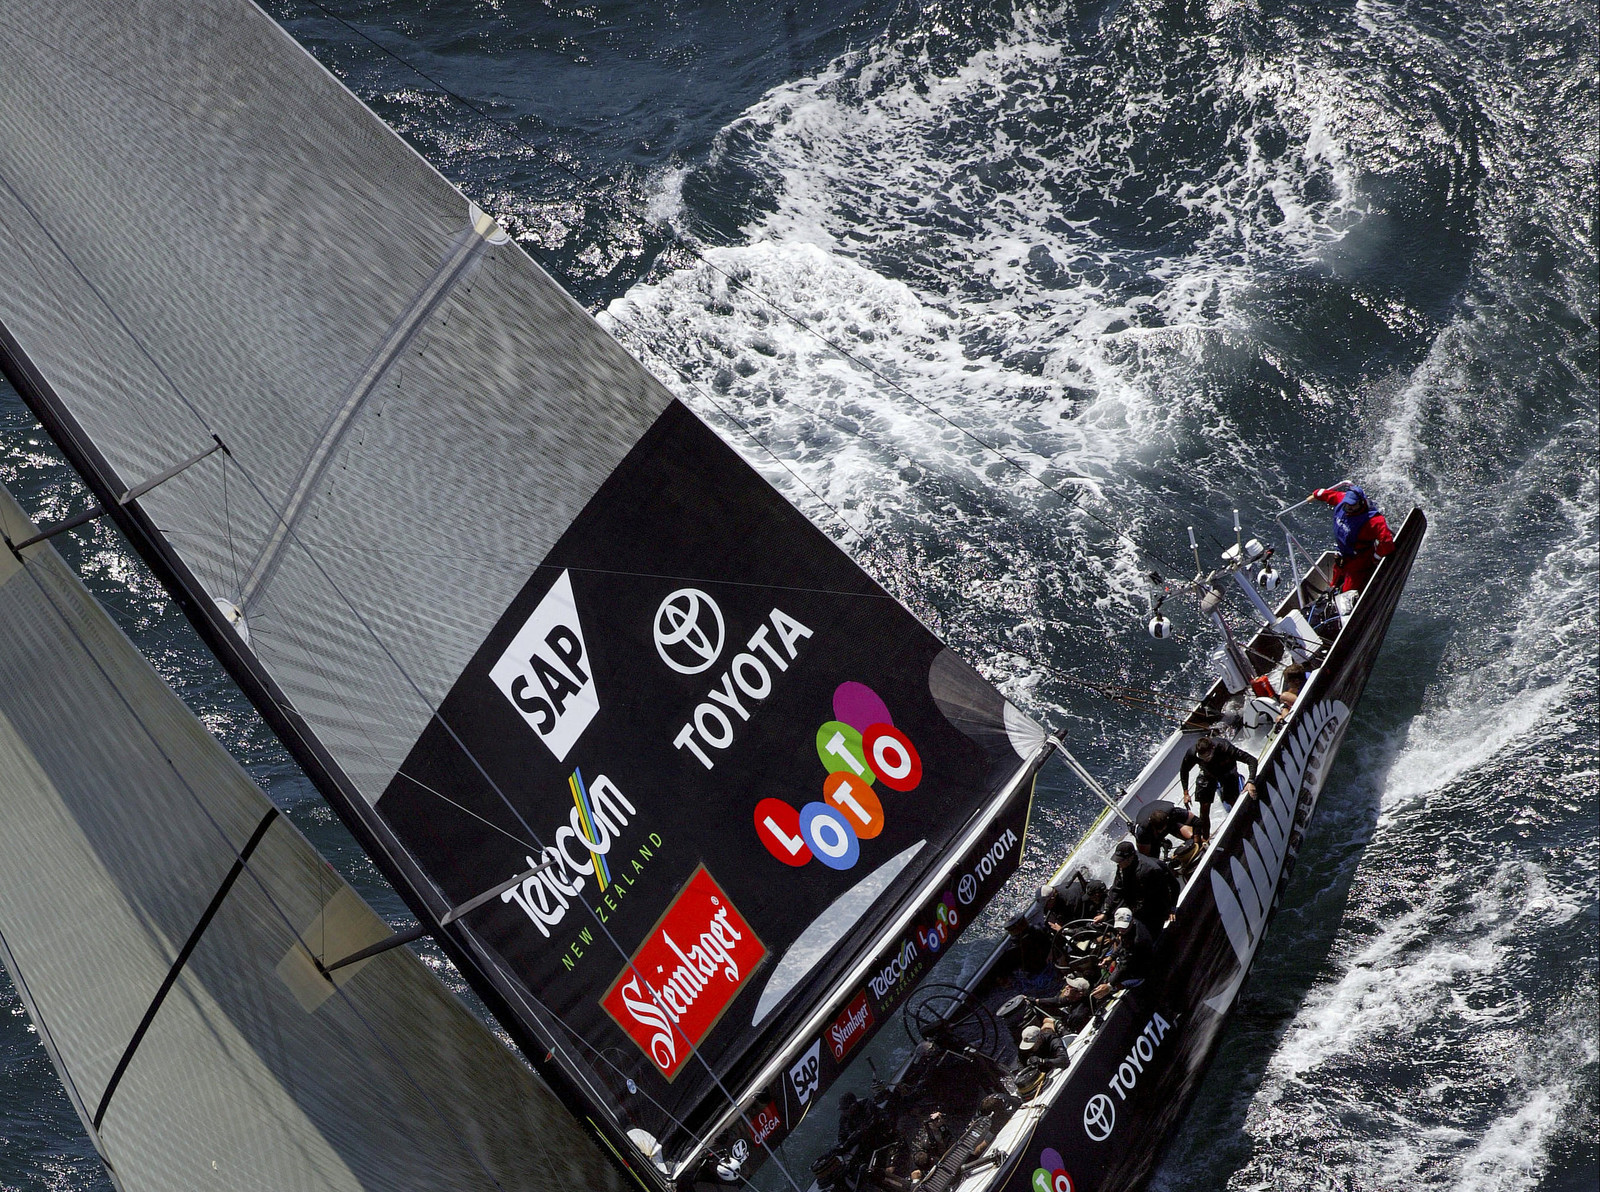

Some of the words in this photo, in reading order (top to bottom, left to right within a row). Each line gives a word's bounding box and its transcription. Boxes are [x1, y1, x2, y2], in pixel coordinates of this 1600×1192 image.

[510, 624, 589, 736] SAP
[673, 608, 814, 770] TOYOTA
[762, 730, 912, 858] LOTTO
[974, 828, 1018, 882] TOYOTA
[561, 926, 594, 972] NEW
[596, 832, 663, 923] ZEALAND
[918, 905, 958, 949] LOTTO
[621, 905, 742, 1069] Steinlager
[868, 940, 918, 1000] Telecom
[831, 1002, 869, 1058] Steinlager
[1108, 1011, 1171, 1101] TOYOTA
[793, 1055, 818, 1097] SAP
[754, 1116, 780, 1145] OMEGA
